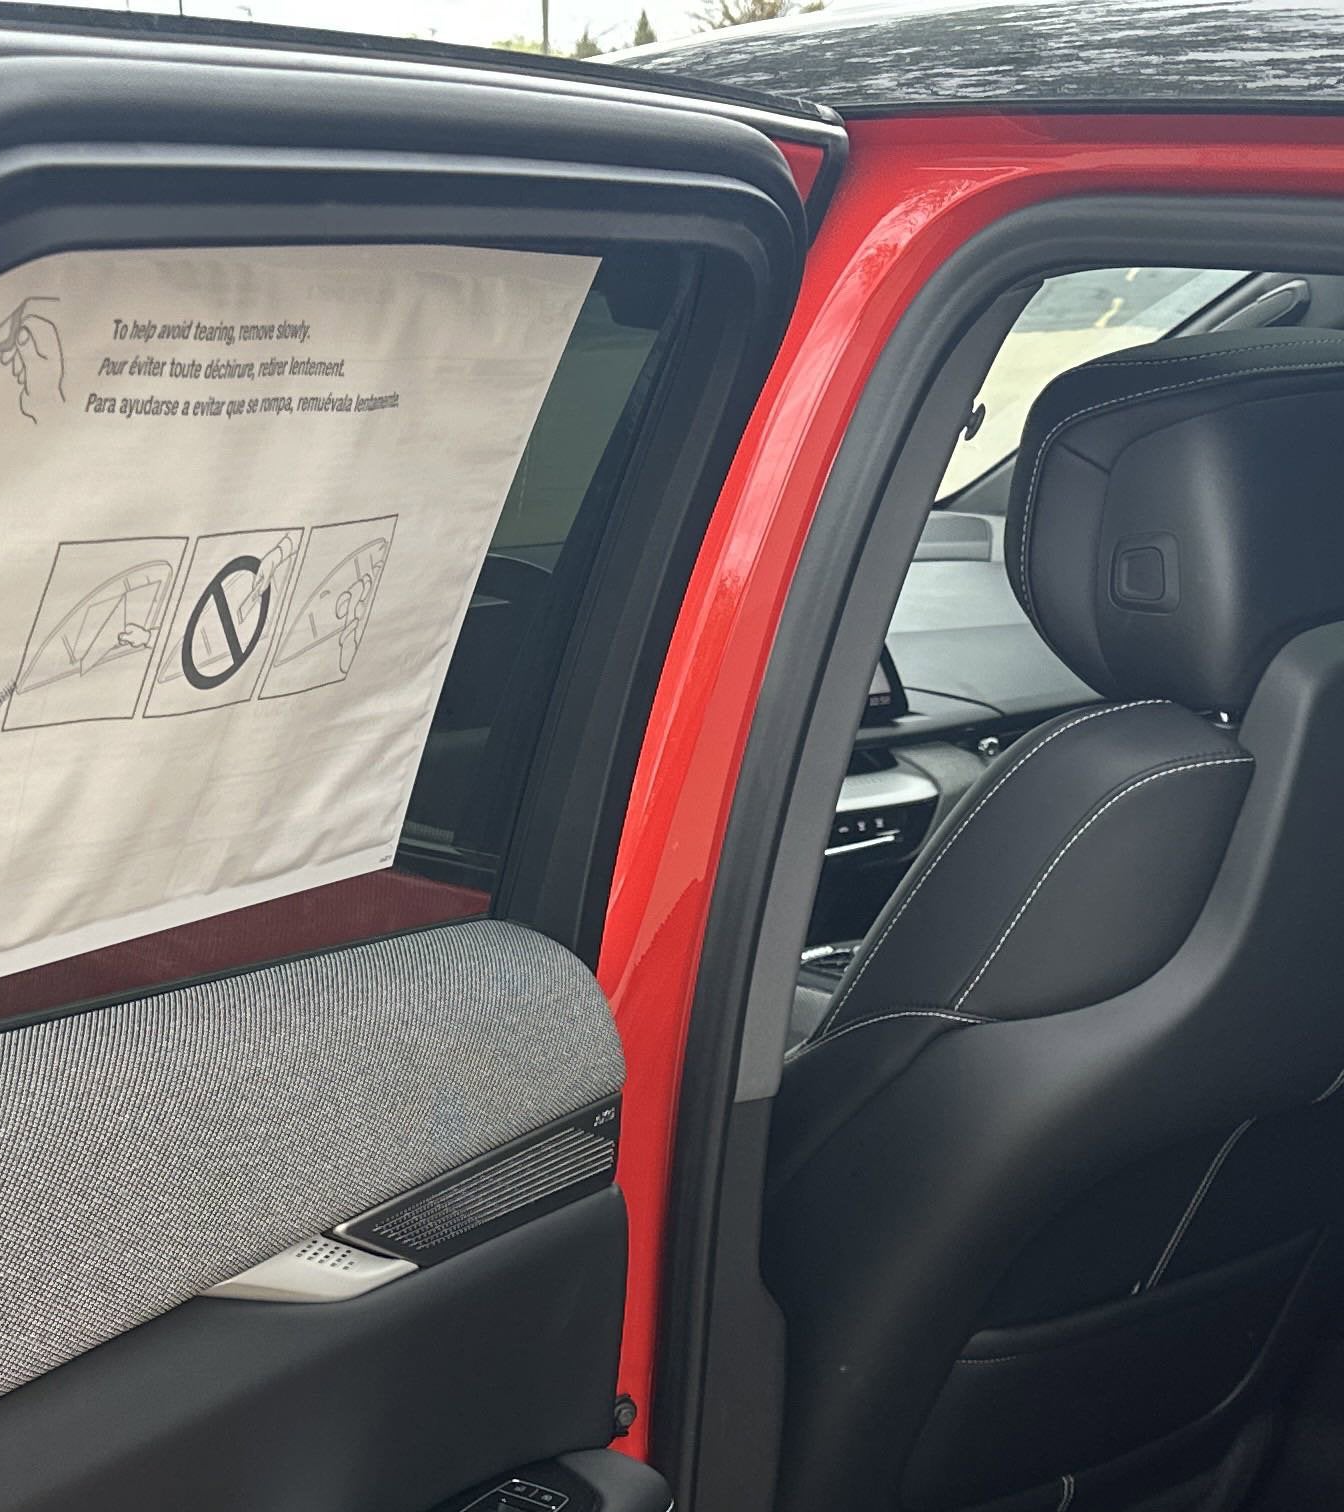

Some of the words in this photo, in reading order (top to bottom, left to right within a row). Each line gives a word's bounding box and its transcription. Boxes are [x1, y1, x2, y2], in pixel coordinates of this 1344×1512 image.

[113, 319, 128, 340] To
[129, 320, 157, 342] help
[157, 320, 193, 340] avoid
[194, 322, 235, 346] tearing,
[239, 324, 275, 341] remove
[276, 320, 310, 343] slowly.
[98, 357, 128, 376] Pour
[129, 355, 167, 376] éviter
[169, 358, 203, 379] toute
[204, 358, 255, 380] déchirure,
[258, 357, 288, 377] retirer
[288, 356, 345, 377] lentement.
[85, 393, 116, 414] Para
[119, 395, 179, 418] ayudarse
[181, 400, 191, 416] a
[193, 395, 226, 416] evitar
[226, 400, 246, 419] que
[246, 399, 259, 415] se
[260, 396, 293, 416] rompa,
[296, 391, 353, 412] remuévala
